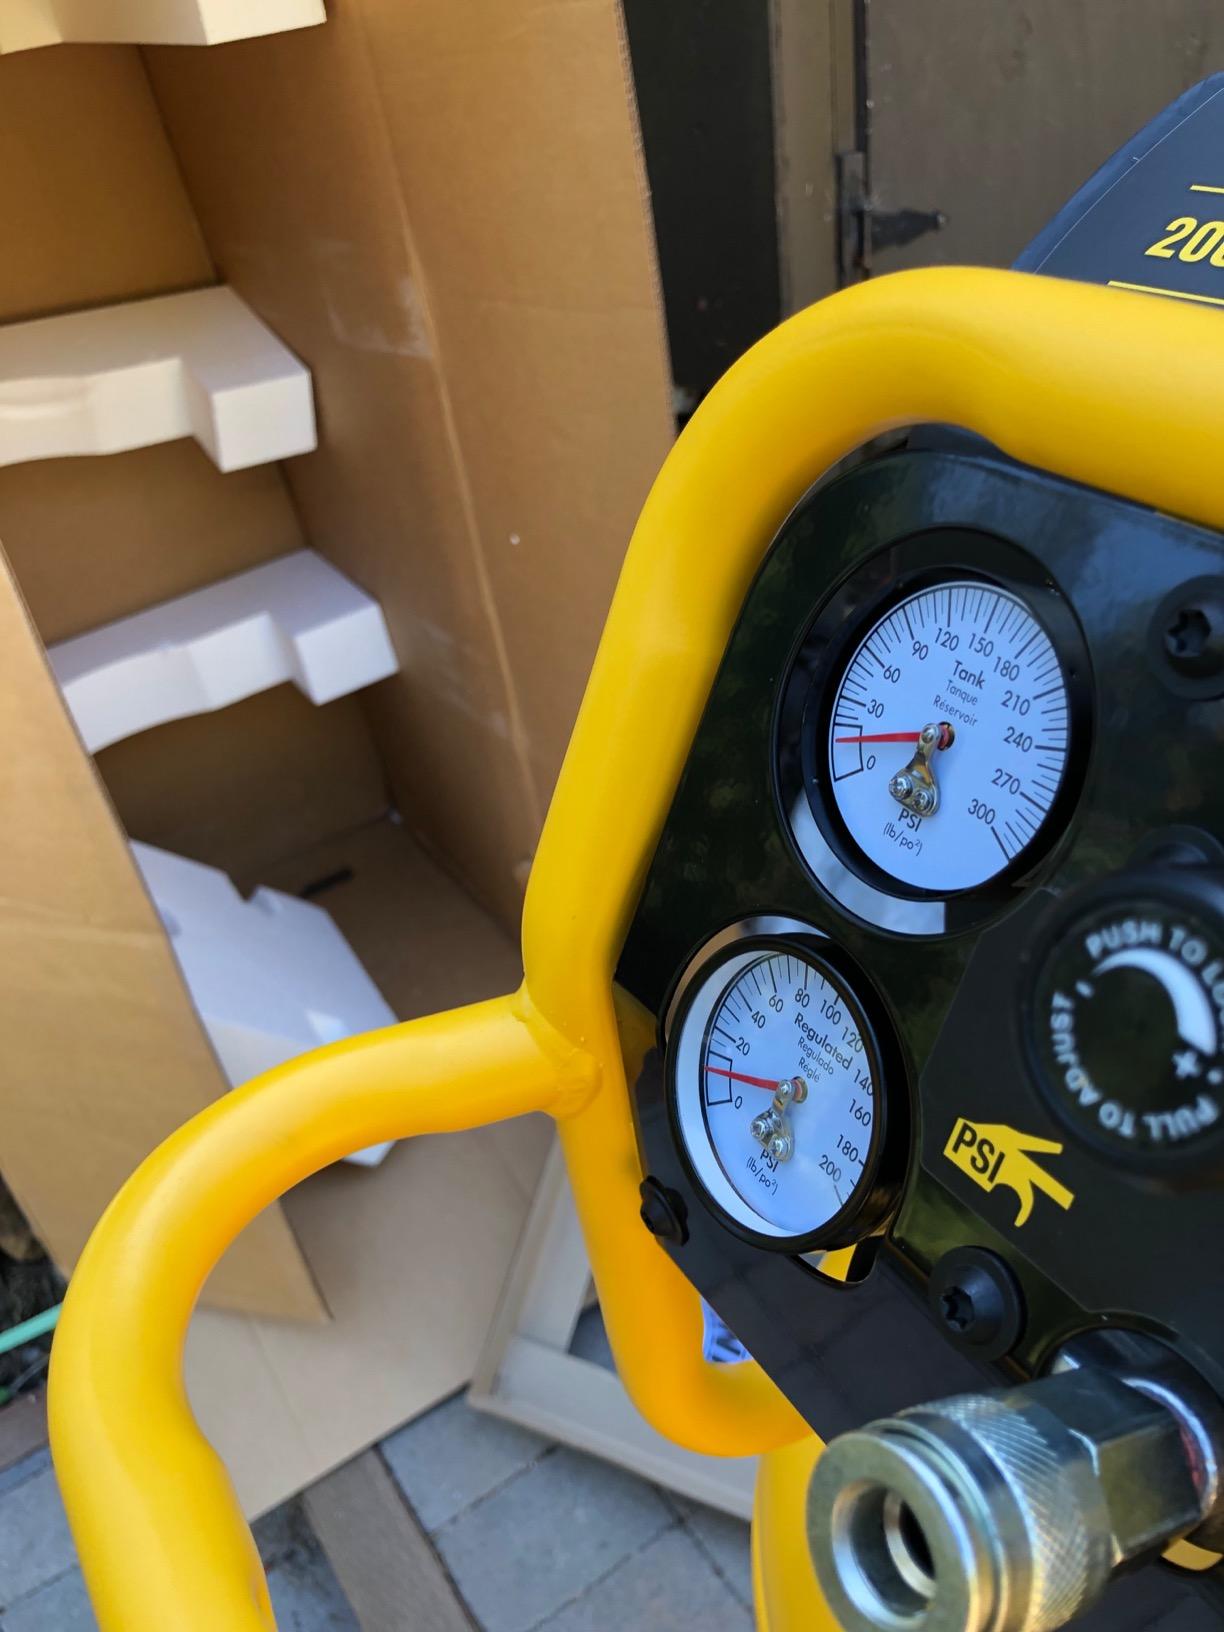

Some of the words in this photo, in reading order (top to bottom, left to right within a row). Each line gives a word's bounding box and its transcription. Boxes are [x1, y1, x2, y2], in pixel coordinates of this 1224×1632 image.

[912, 641, 929, 661] 90
[934, 628, 960, 651] 120
[967, 633, 994, 657] 150
[883, 665, 901, 684] 60
[953, 660, 985, 690] Tank
[993, 657, 1020, 682] 180
[946, 680, 978, 706] Tanque
[1001, 690, 1031, 716] 210
[867, 699, 884, 719] 30
[933, 694, 978, 727] Réservoir
[1003, 726, 1033, 752] 240
[866, 755, 876, 770] 0
[991, 768, 1021, 795] 270
[898, 807, 922, 833] PSI
[967, 799, 996, 825] 300
[1085, 919, 1163, 960] PUSH
[1168, 925, 1207, 965] TO
[768, 995, 784, 1013] 60
[795, 988, 810, 1008] 80
[751, 1011, 766, 1029] 40
[820, 999, 842, 1025] 100
[735, 1038, 750, 1057] 20
[794, 1012, 853, 1071] Regulated
[842, 1027, 863, 1053] 120
[1050, 991, 1103, 1107] ADJUST
[797, 1036, 834, 1075] Regulado
[854, 1069, 874, 1096] 140
[734, 1096, 743, 1109] 0
[849, 1098, 872, 1127] 160
[1099, 1101, 1136, 1138] TO
[1142, 1094, 1220, 1142] PULL
[760, 1148, 779, 1173] PSI
[837, 1134, 859, 1162] 180
[952, 1122, 1006, 1182] PSI
[818, 1154, 842, 1183] 200
